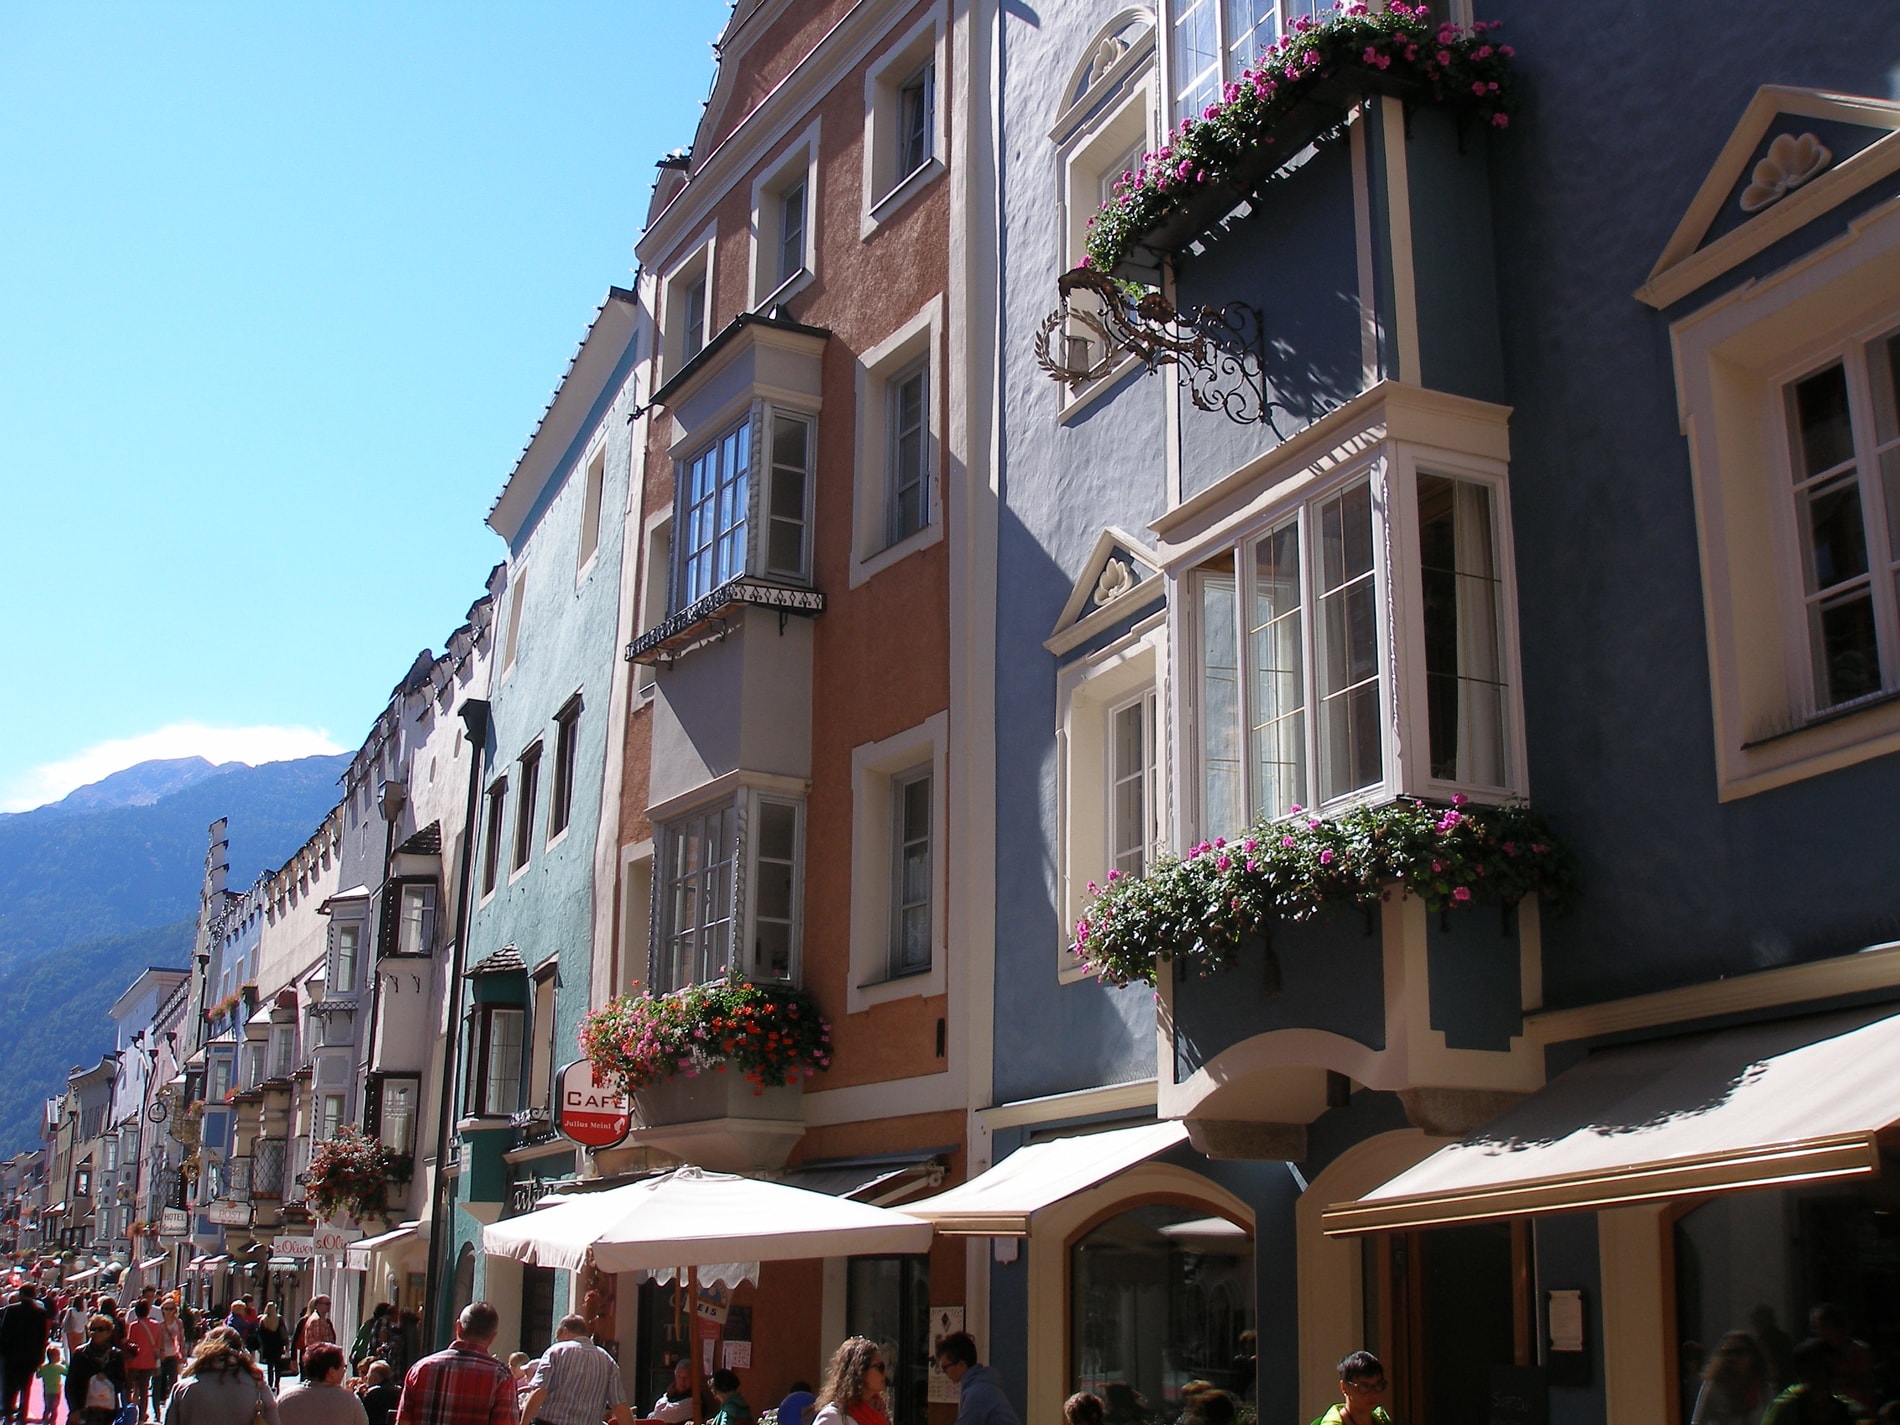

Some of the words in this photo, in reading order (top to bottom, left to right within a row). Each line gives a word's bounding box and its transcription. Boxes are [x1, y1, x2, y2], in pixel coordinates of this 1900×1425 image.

[564, 1120, 588, 1128] Julius
[590, 1121, 611, 1129] Meinl
[164, 1212, 185, 1221] HOTEL
[218, 1209, 244, 1220] POST
[276, 1240, 313, 1254] s.Oliver
[697, 1303, 717, 1317] EIS
